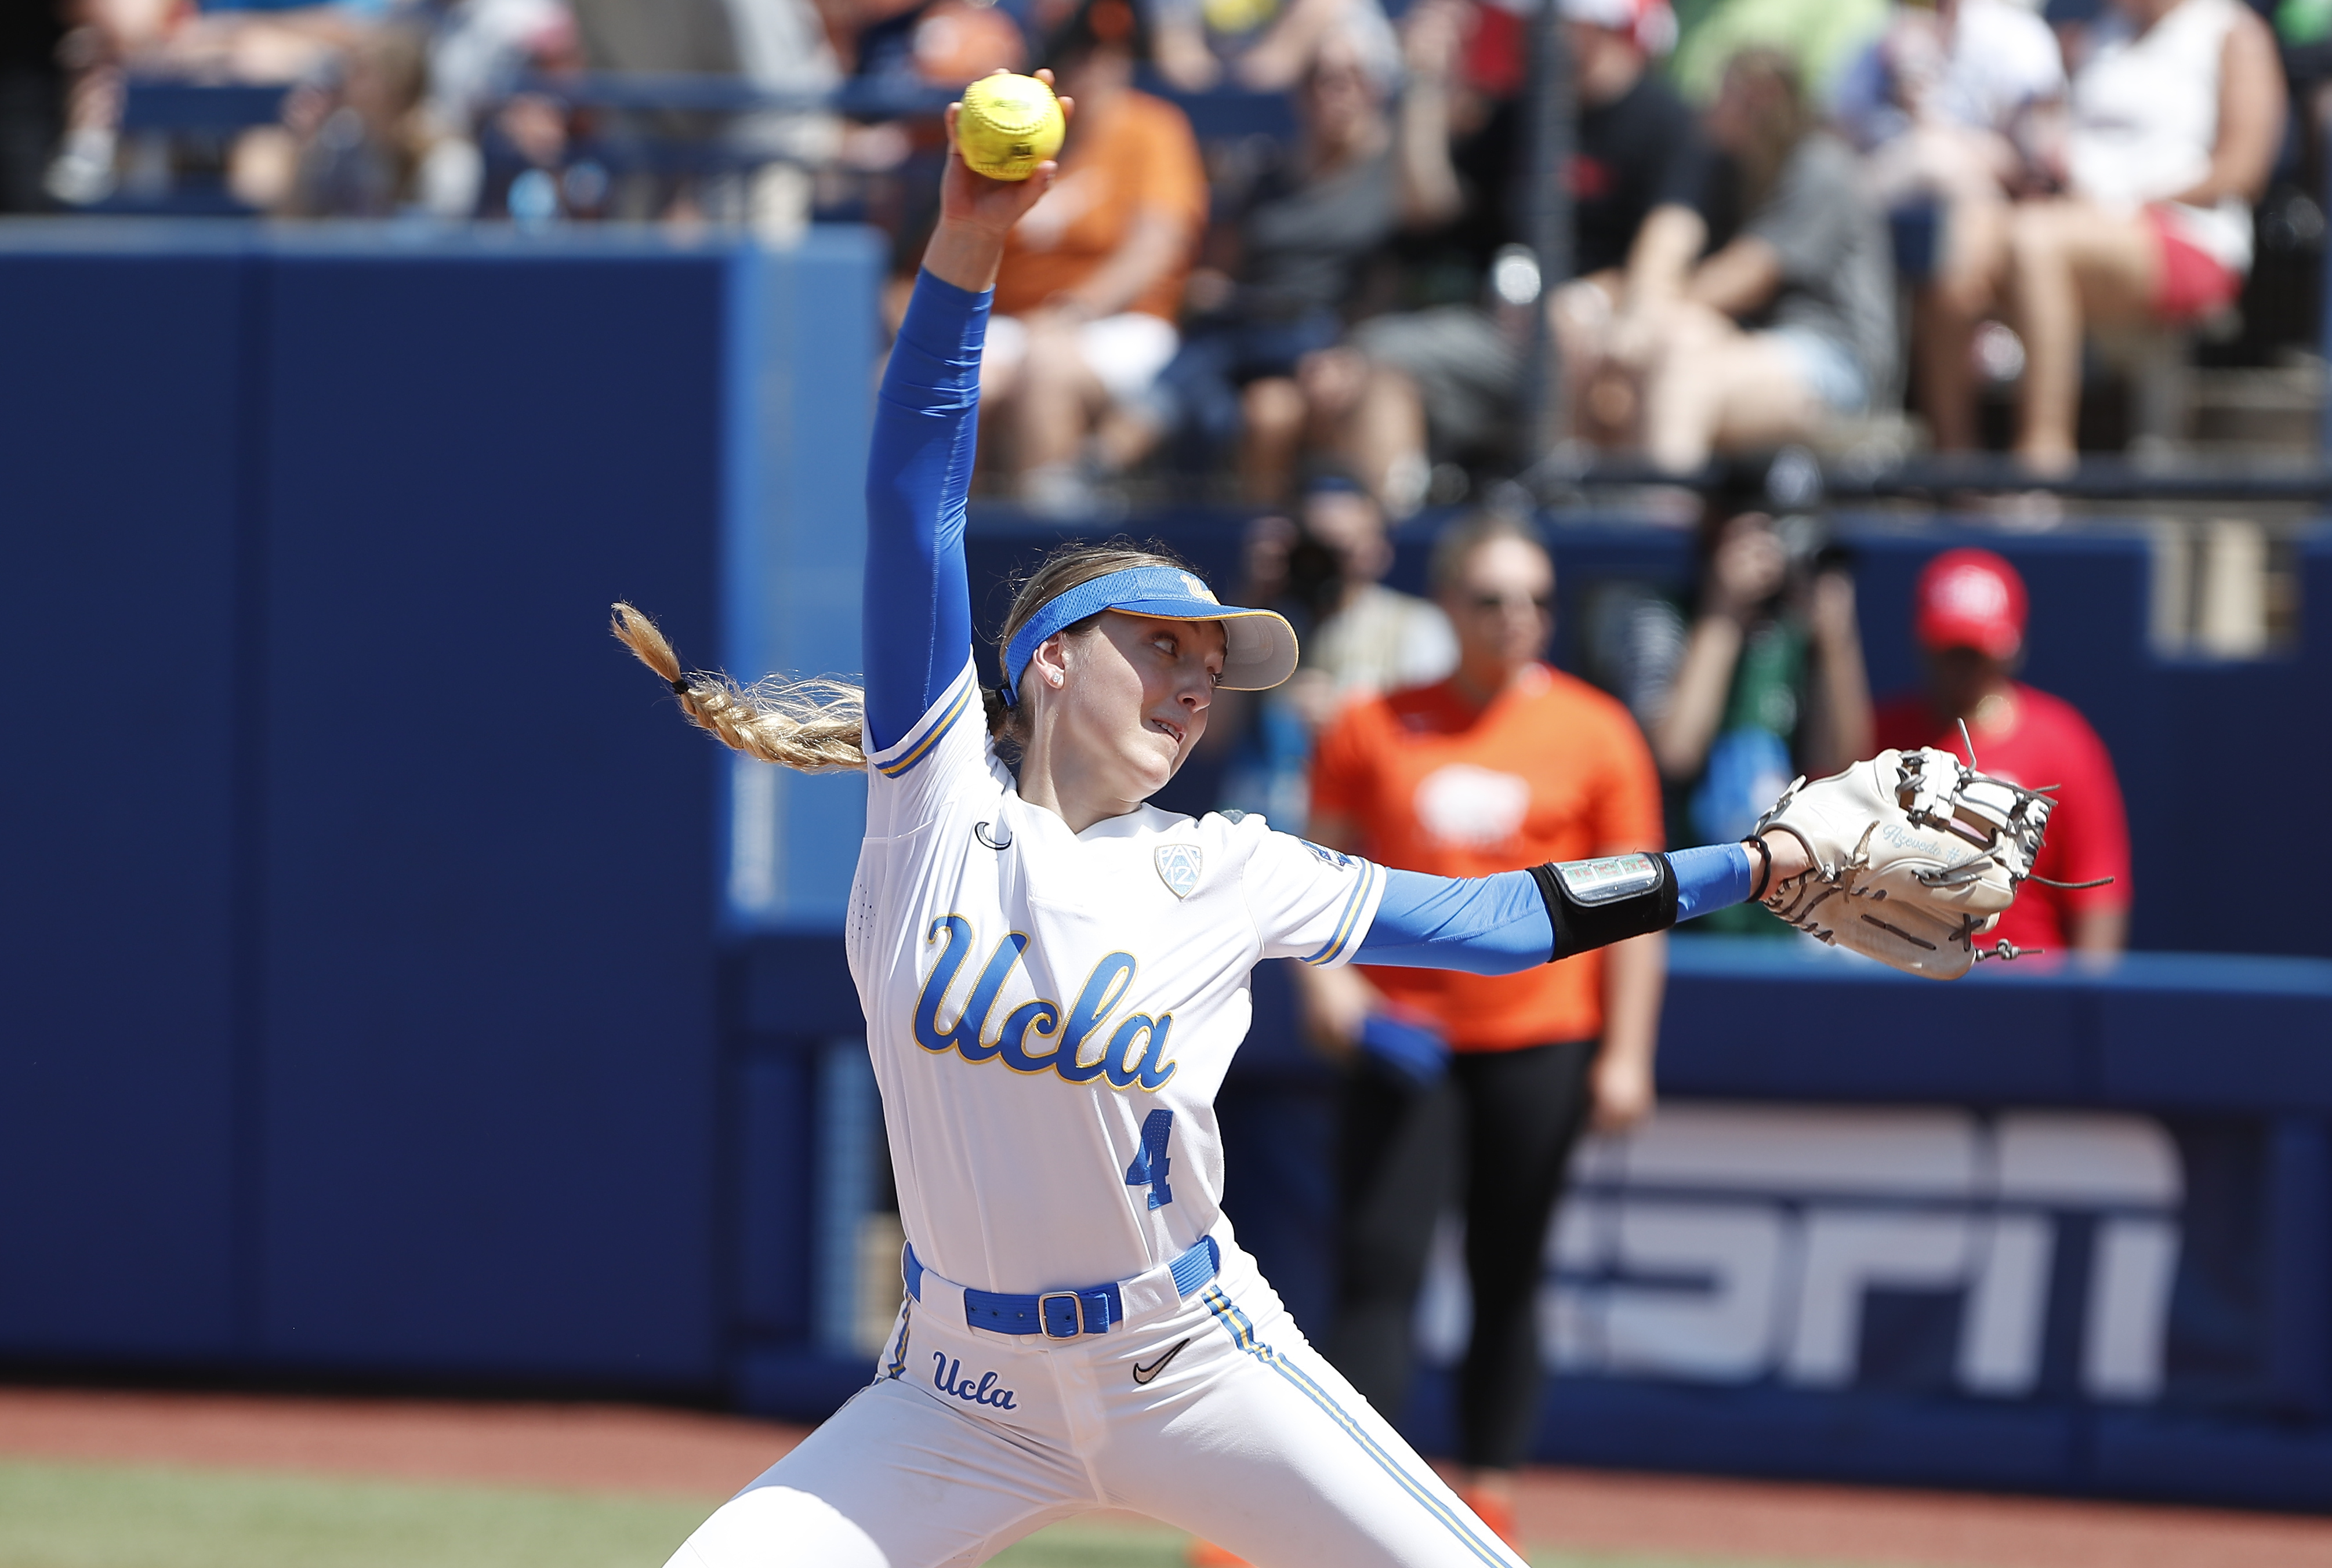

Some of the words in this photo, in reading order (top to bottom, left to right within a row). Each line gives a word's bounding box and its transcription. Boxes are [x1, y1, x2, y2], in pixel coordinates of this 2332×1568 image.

[1158, 845, 1201, 877] PAC
[1883, 824, 1942, 856] Azevedo
[1170, 865, 1192, 885] 12
[912, 912, 1178, 1094] Ucla
[1126, 1108, 1174, 1211] 4
[933, 1351, 1017, 1410] Ucla
